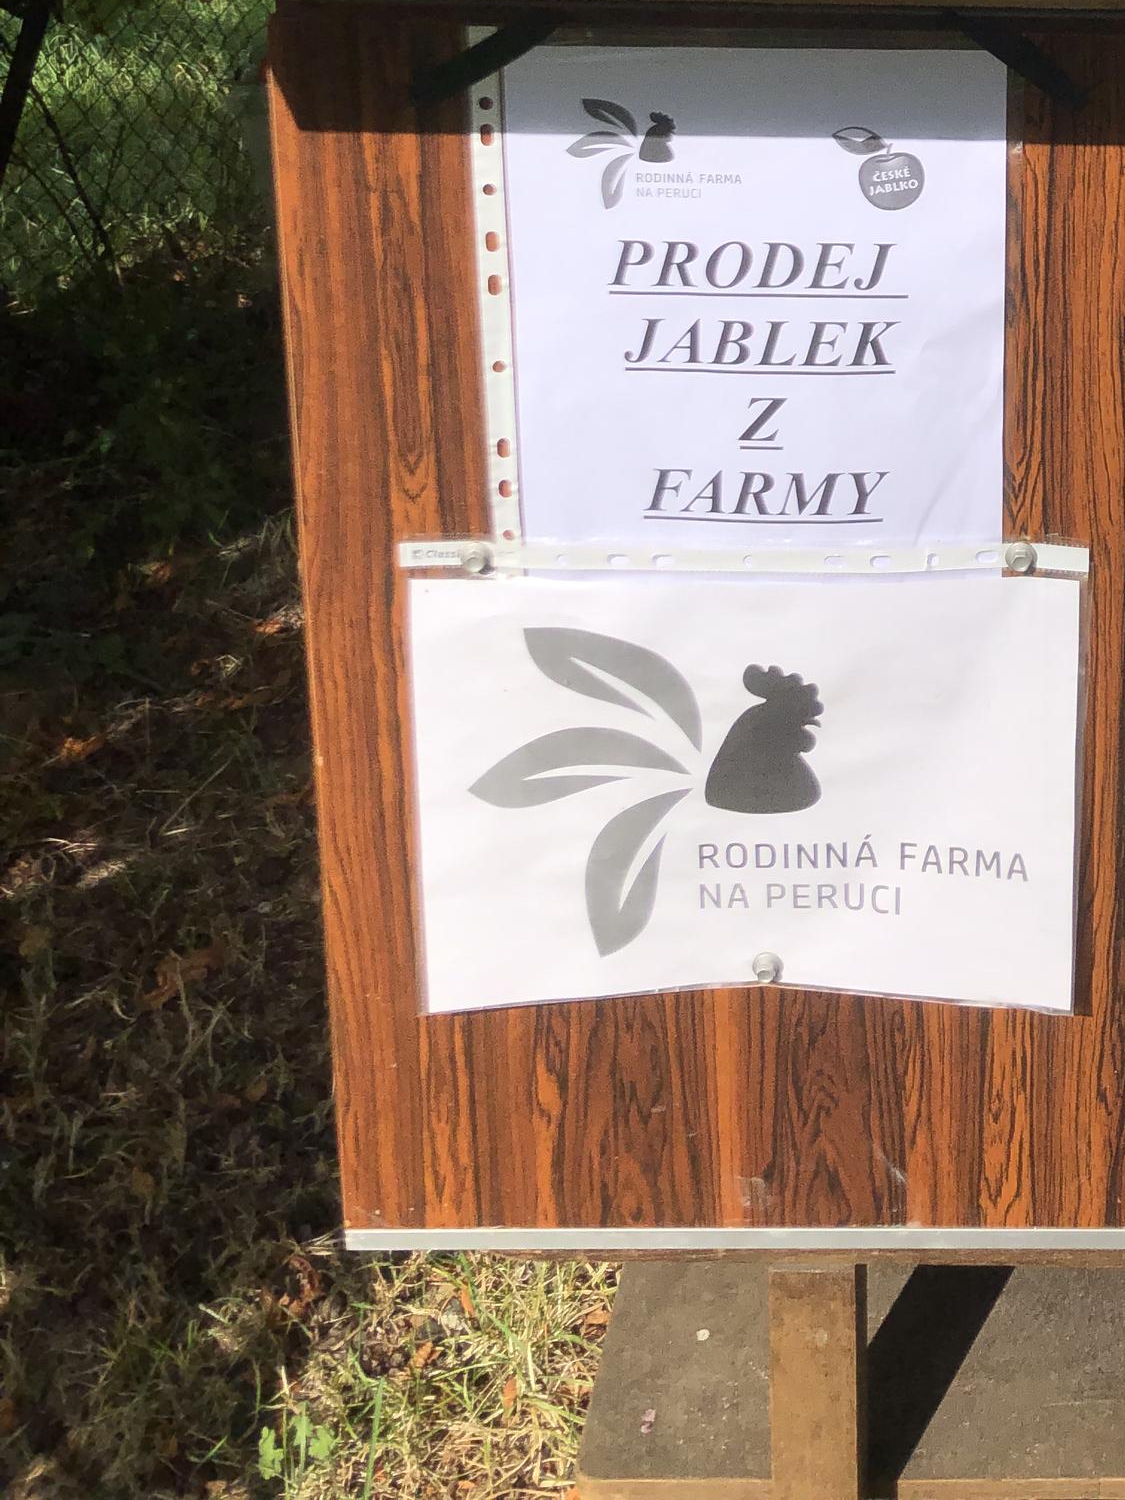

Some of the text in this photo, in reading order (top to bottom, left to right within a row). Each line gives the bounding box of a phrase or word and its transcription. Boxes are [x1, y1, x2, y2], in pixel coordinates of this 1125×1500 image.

[636, 171, 742, 185] RODINNÁ FARMA
[636, 187, 702, 199] NA PERUCI
[869, 179, 919, 196] JABLKO
[873, 166, 911, 182] ČESKÉ
[608, 239, 897, 291] PRODEJ
[624, 318, 902, 367] JABLEK
[738, 397, 788, 442] Z
[643, 468, 890, 516] FARMY
[698, 834, 1029, 882] RODINNÁ FARMA
[699, 882, 902, 916] NA PERUCI
